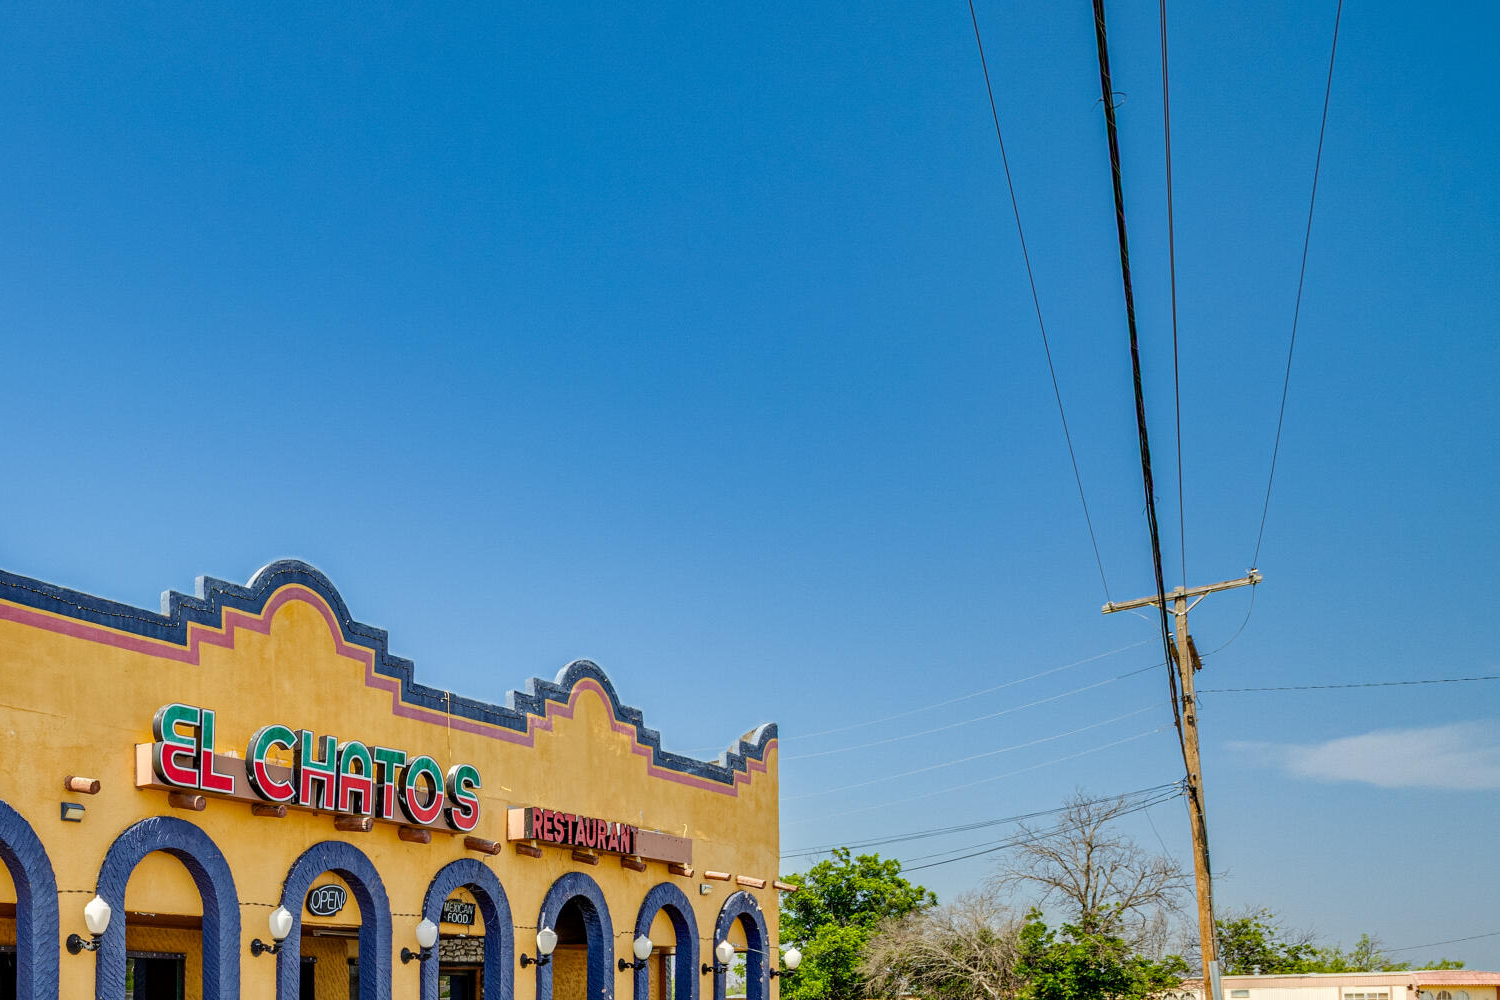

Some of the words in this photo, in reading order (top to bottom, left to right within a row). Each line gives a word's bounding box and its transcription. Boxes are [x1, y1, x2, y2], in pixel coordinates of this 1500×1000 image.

[153, 703, 235, 795] EL
[245, 724, 481, 832] CHATOS
[532, 806, 638, 854] RESTAURANT
[311, 890, 344, 909] OPEN
[444, 902, 474, 915] MEXICAN
[447, 912, 469, 924] FOOD
